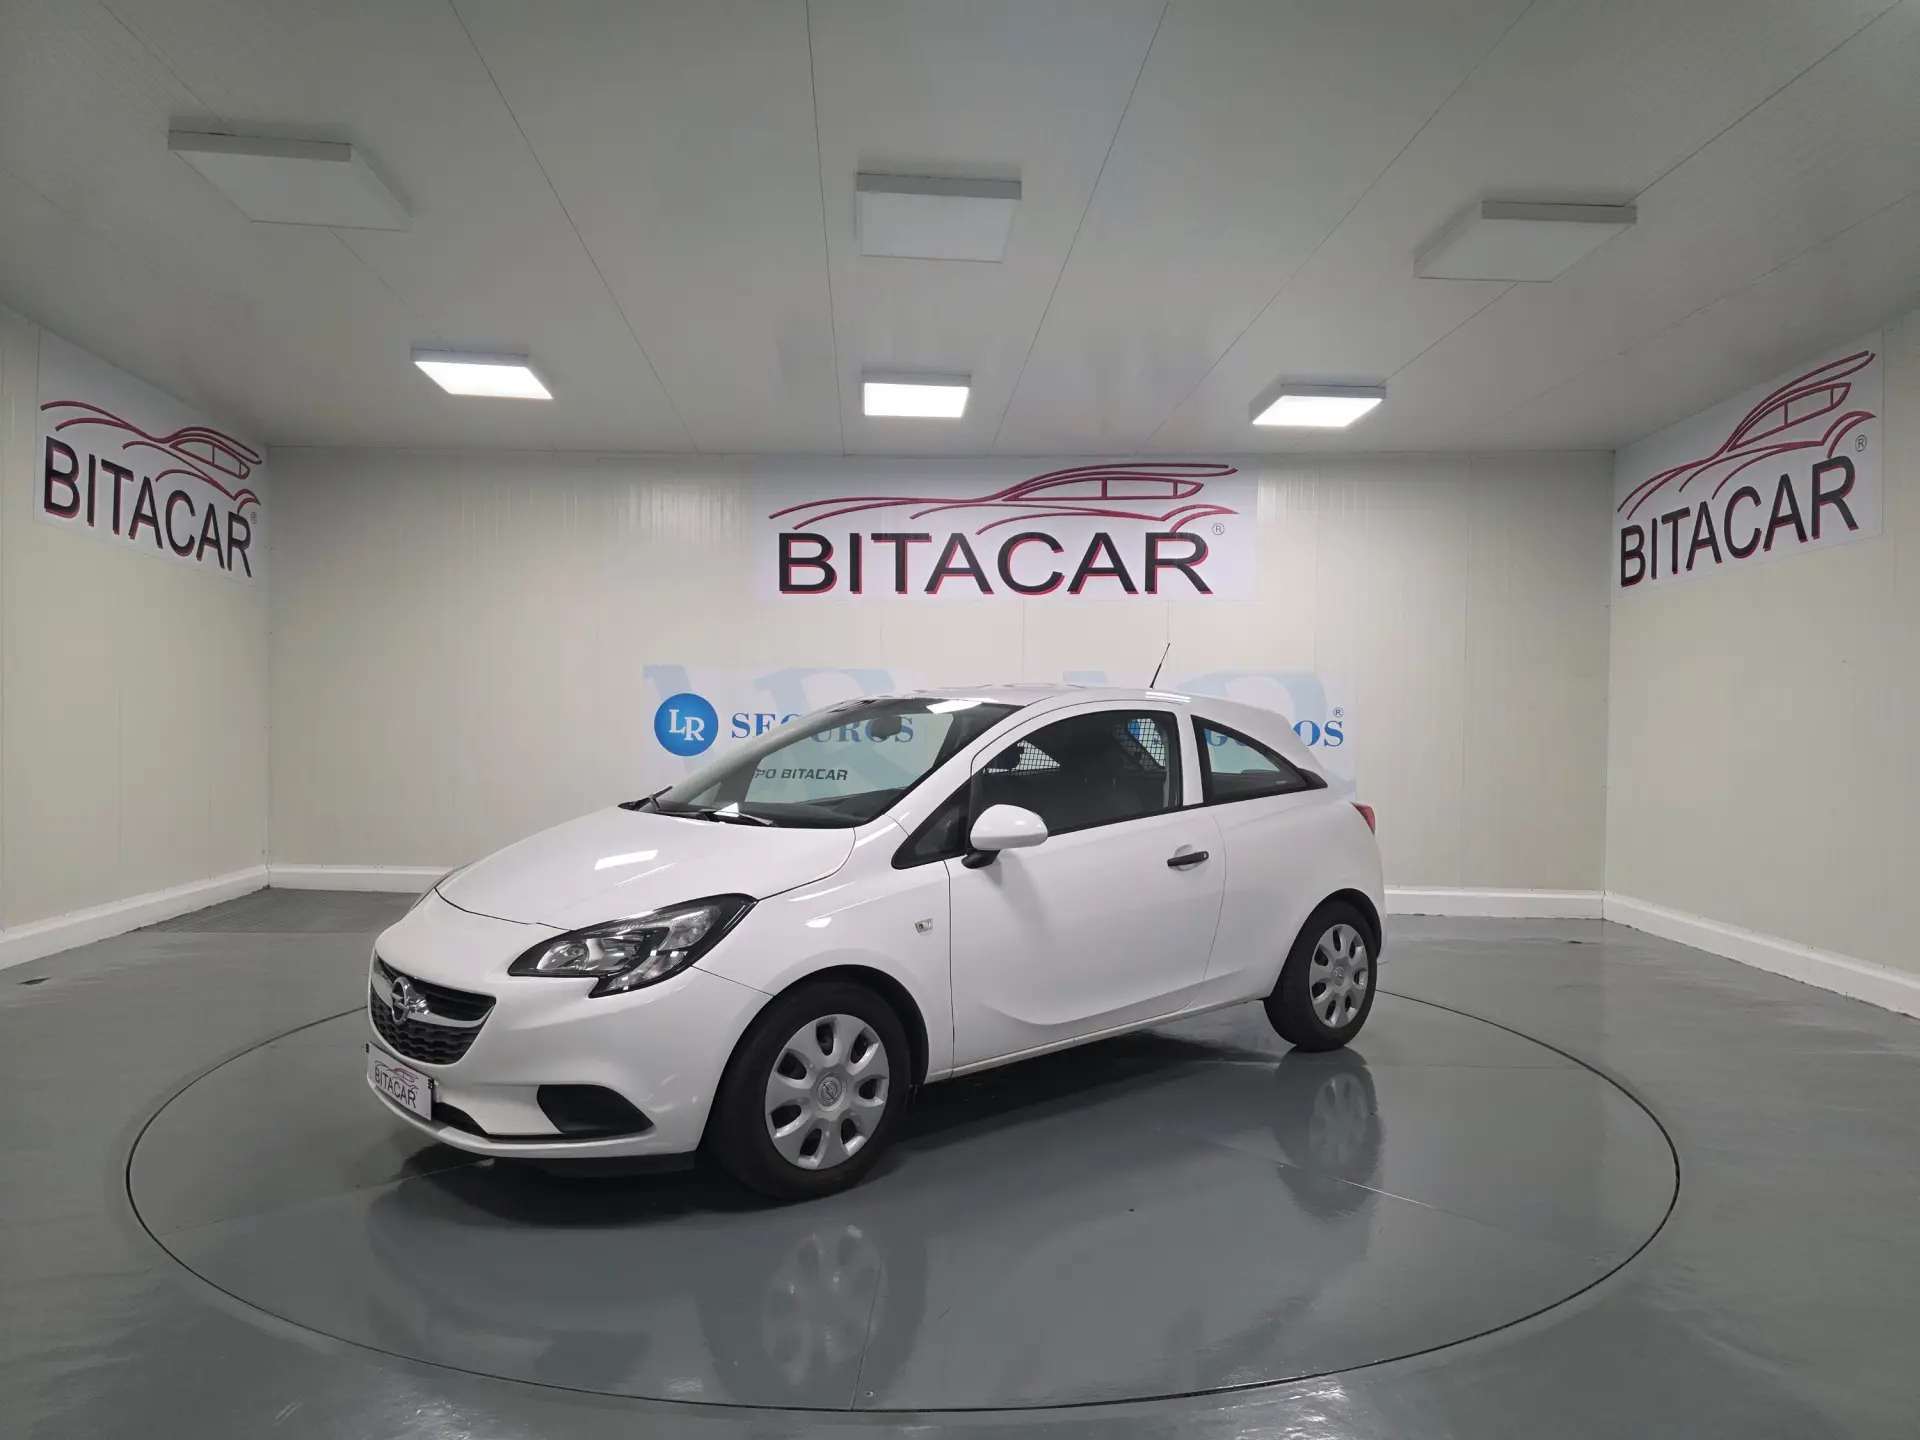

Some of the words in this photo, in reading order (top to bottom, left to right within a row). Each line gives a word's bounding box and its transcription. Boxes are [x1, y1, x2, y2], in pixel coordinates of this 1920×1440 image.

[44, 436, 252, 578] BITACAR
[1620, 456, 1859, 588] BITACAR
[778, 532, 1213, 595] BITACAR
[668, 708, 705, 742] LR
[731, 712, 914, 743] SEURS
[780, 768, 848, 781] BITACAR
[374, 1065, 417, 1109] BITACAR
